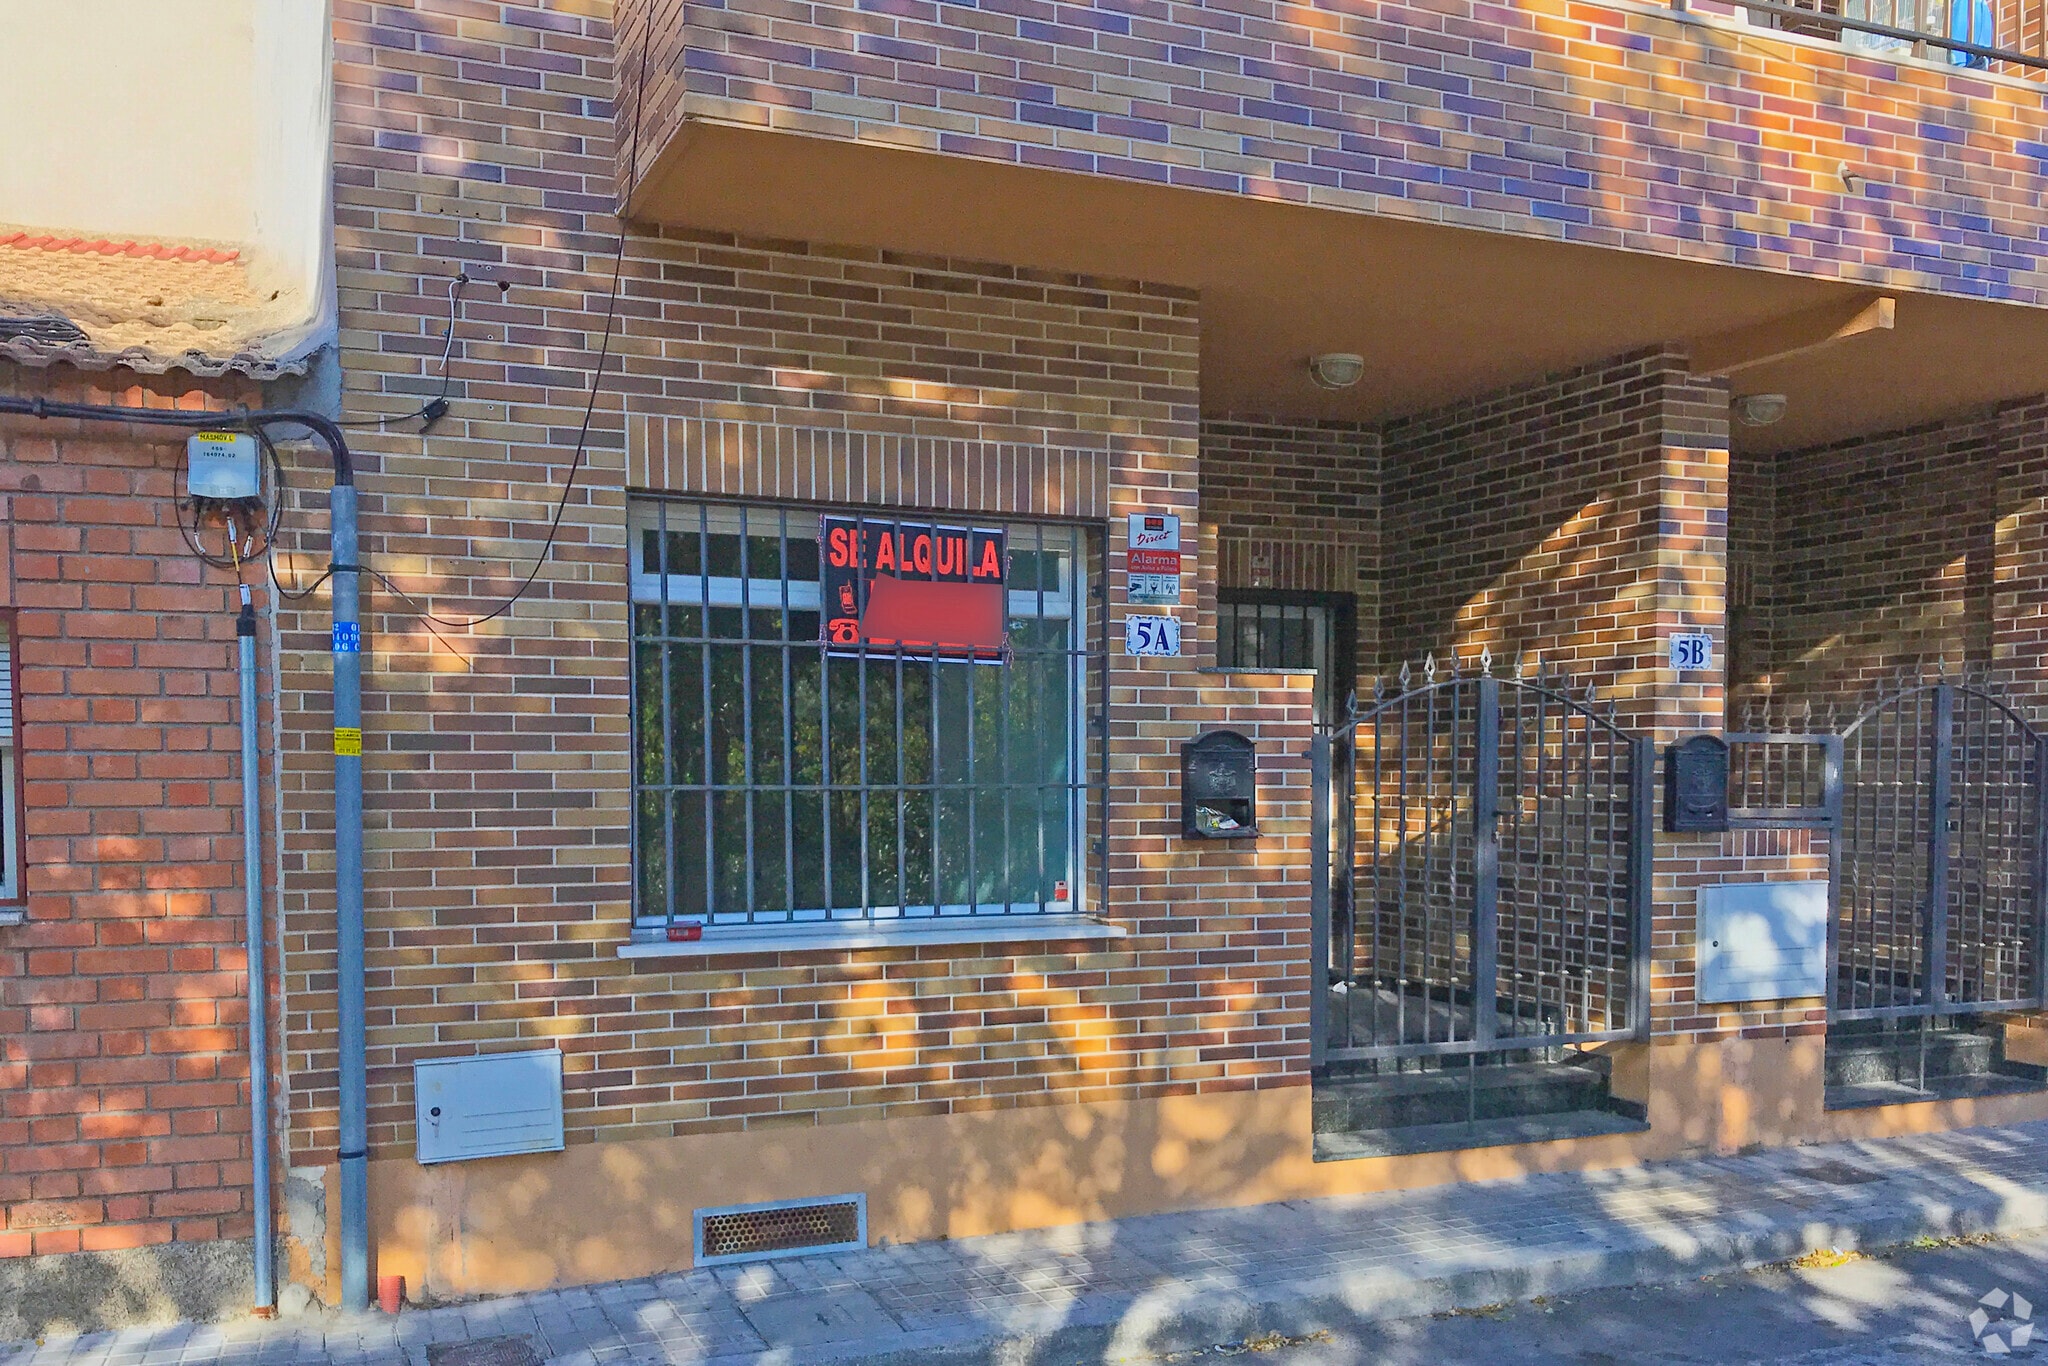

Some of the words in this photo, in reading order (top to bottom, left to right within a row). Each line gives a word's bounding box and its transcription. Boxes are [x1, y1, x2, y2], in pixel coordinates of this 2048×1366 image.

[830, 527, 867, 568] SE
[1137, 530, 1173, 545] Direct
[1131, 552, 1178, 565] Alarma
[1137, 622, 1170, 651] 5A
[1678, 639, 1704, 664] 5B
